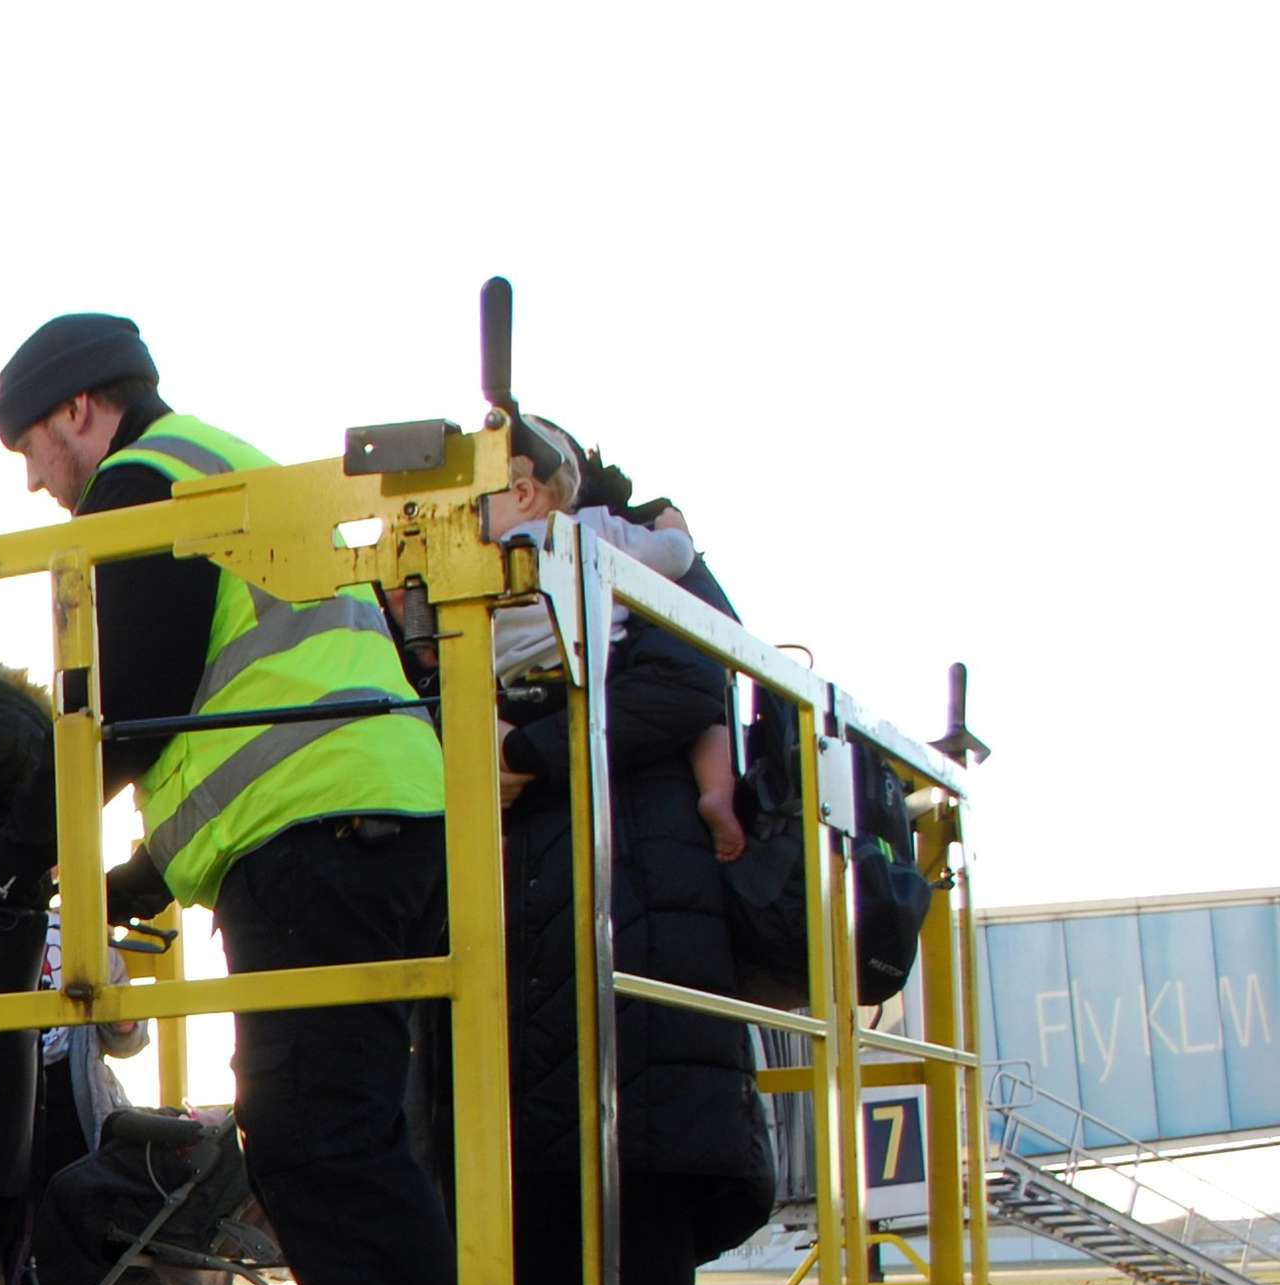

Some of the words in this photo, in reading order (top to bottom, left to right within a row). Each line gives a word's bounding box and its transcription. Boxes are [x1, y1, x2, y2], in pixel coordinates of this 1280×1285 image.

[1035, 976, 1122, 1084] Fly
[1138, 973, 1271, 1056] KLM
[872, 1104, 906, 1181] 7
